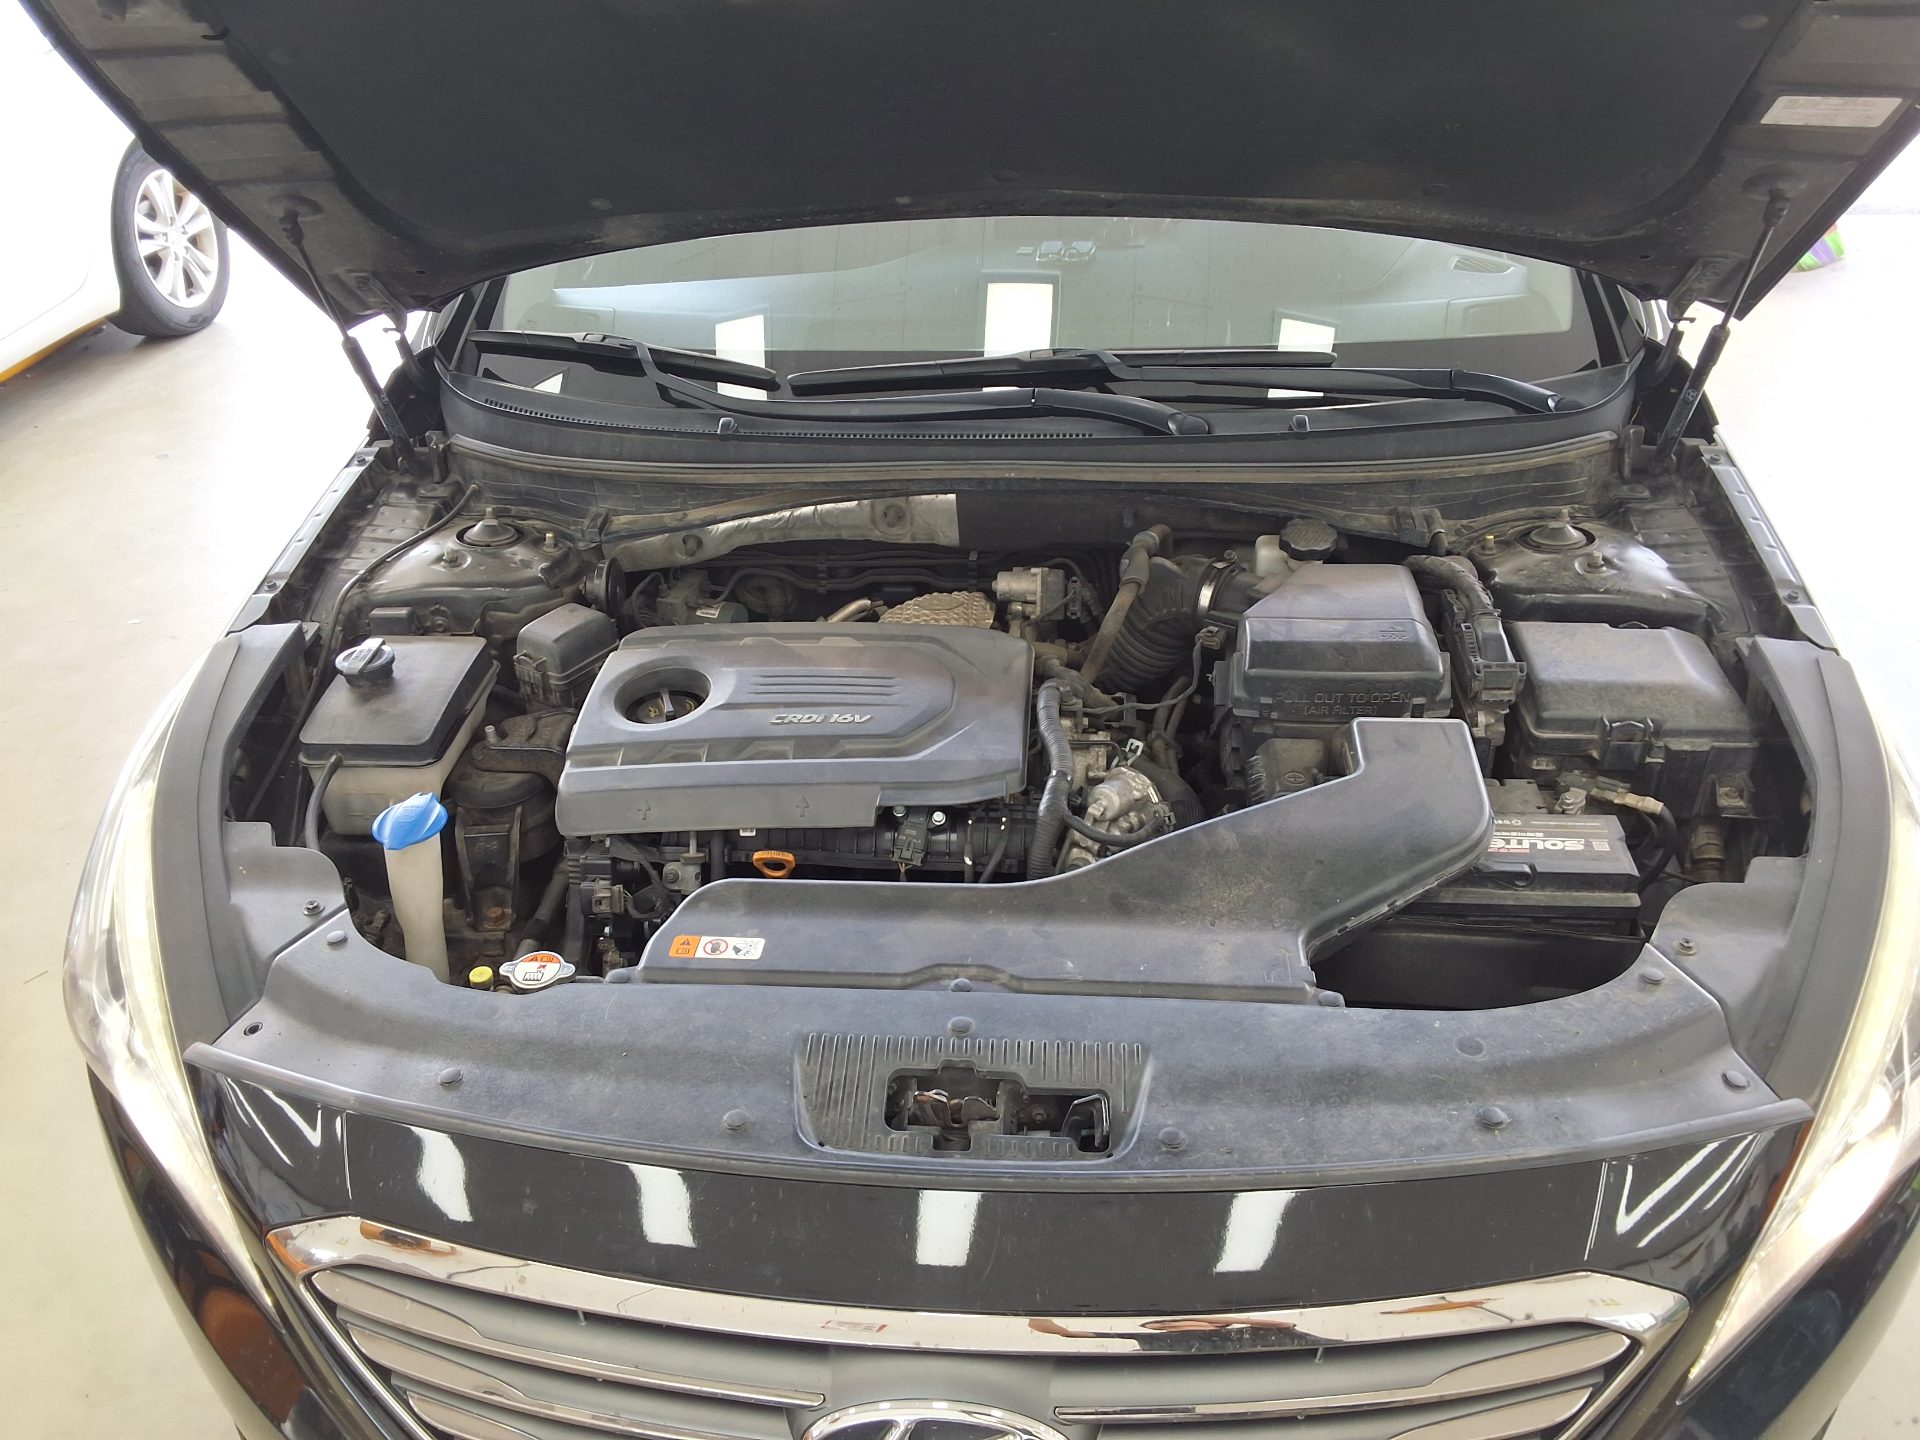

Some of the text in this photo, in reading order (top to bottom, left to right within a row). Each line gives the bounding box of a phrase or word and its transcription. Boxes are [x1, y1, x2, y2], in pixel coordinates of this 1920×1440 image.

[1314, 692, 1345, 703] OUT
[1349, 692, 1367, 703] TO
[1370, 691, 1411, 703] OPEN
[829, 712, 872, 724] 16V
